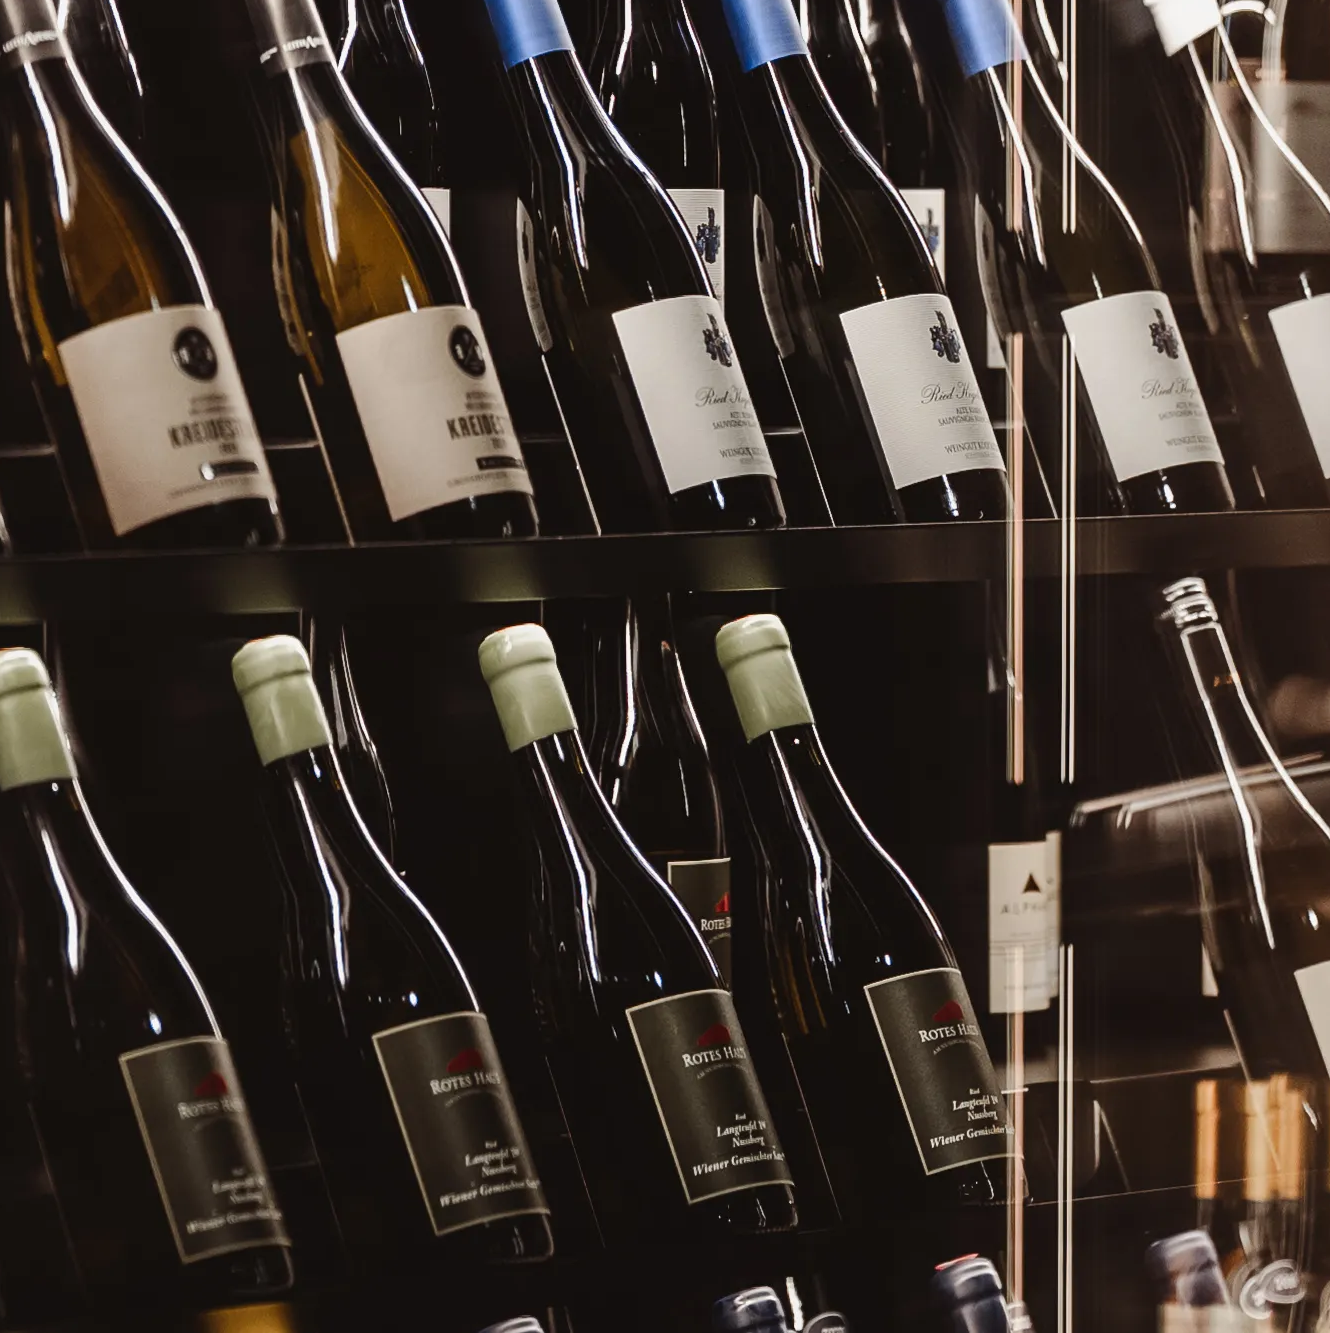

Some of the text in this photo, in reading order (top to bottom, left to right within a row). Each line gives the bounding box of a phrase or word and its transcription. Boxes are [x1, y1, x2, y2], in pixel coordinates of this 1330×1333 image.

[694, 386, 730, 408] Ried
[920, 383, 955, 405] Ried
[918, 1024, 957, 1043] ROTES
[681, 1049, 721, 1069] ROTES
[930, 1134, 966, 1150] Wiener
[692, 1158, 730, 1177] Wiener
